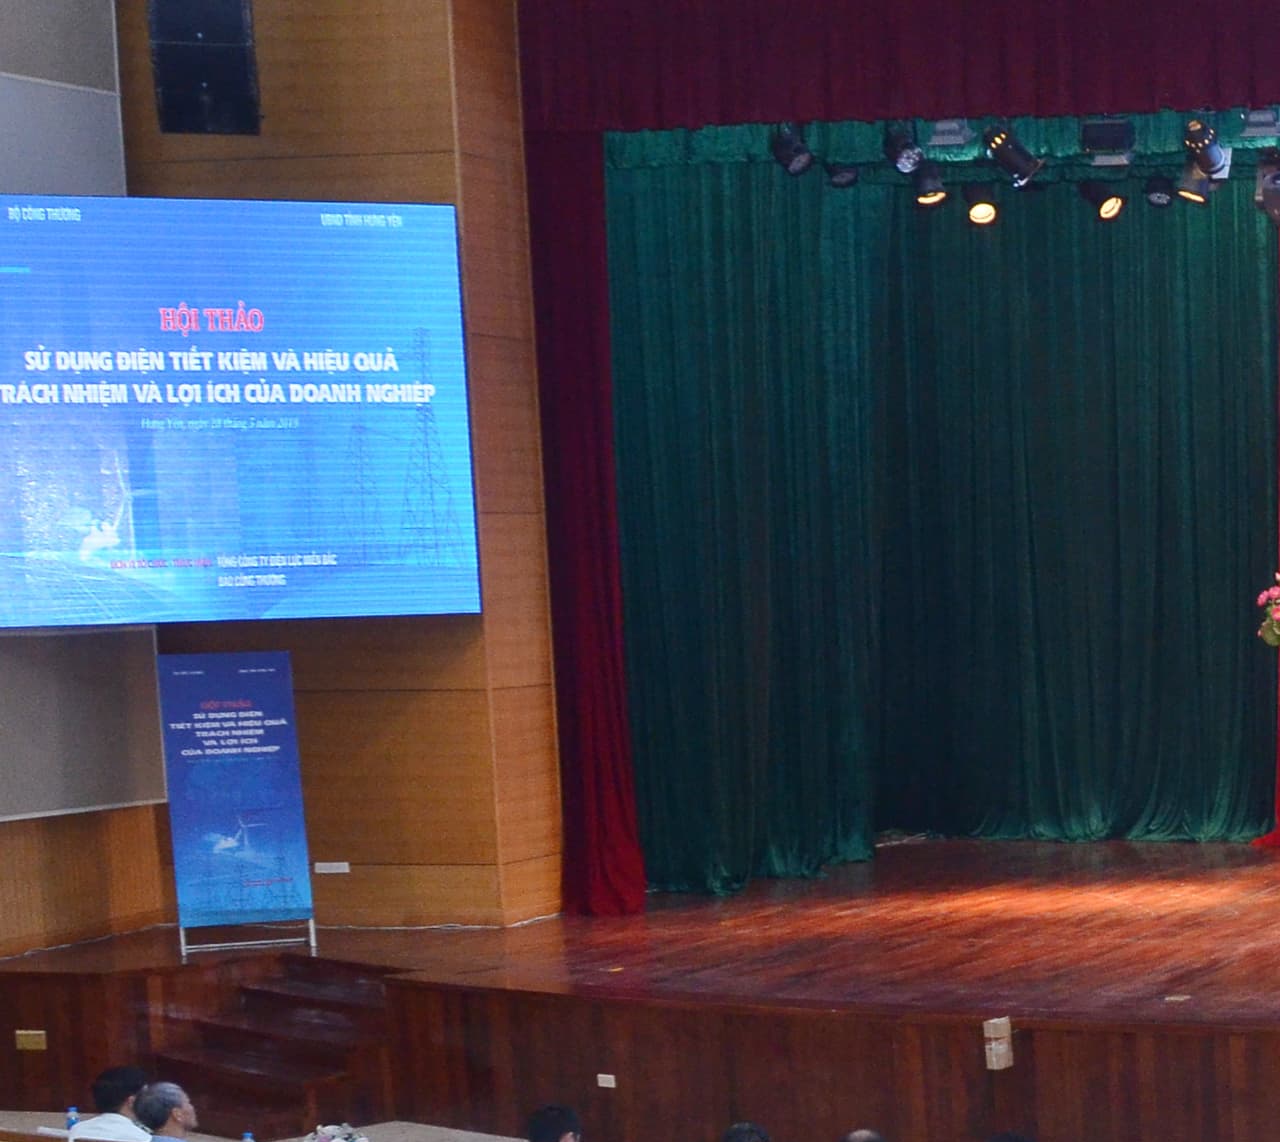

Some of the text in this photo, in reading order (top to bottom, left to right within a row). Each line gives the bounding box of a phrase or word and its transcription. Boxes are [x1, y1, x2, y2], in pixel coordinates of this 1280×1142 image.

[159, 300, 265, 337] HỘI THẢO
[24, 344, 398, 375] SỬ DỤNG ĐIỆN TIẾT KIỆM VÀ HIỆU QUẢ
[62, 380, 128, 407] NHIỆM
[132, 379, 163, 404] VÀ
[166, 383, 202, 407] LỢI
[206, 379, 240, 403] ÍCH
[244, 377, 287, 403] CỦA
[289, 383, 361, 403] DOANH
[365, 380, 436, 407] NGHIỆP
